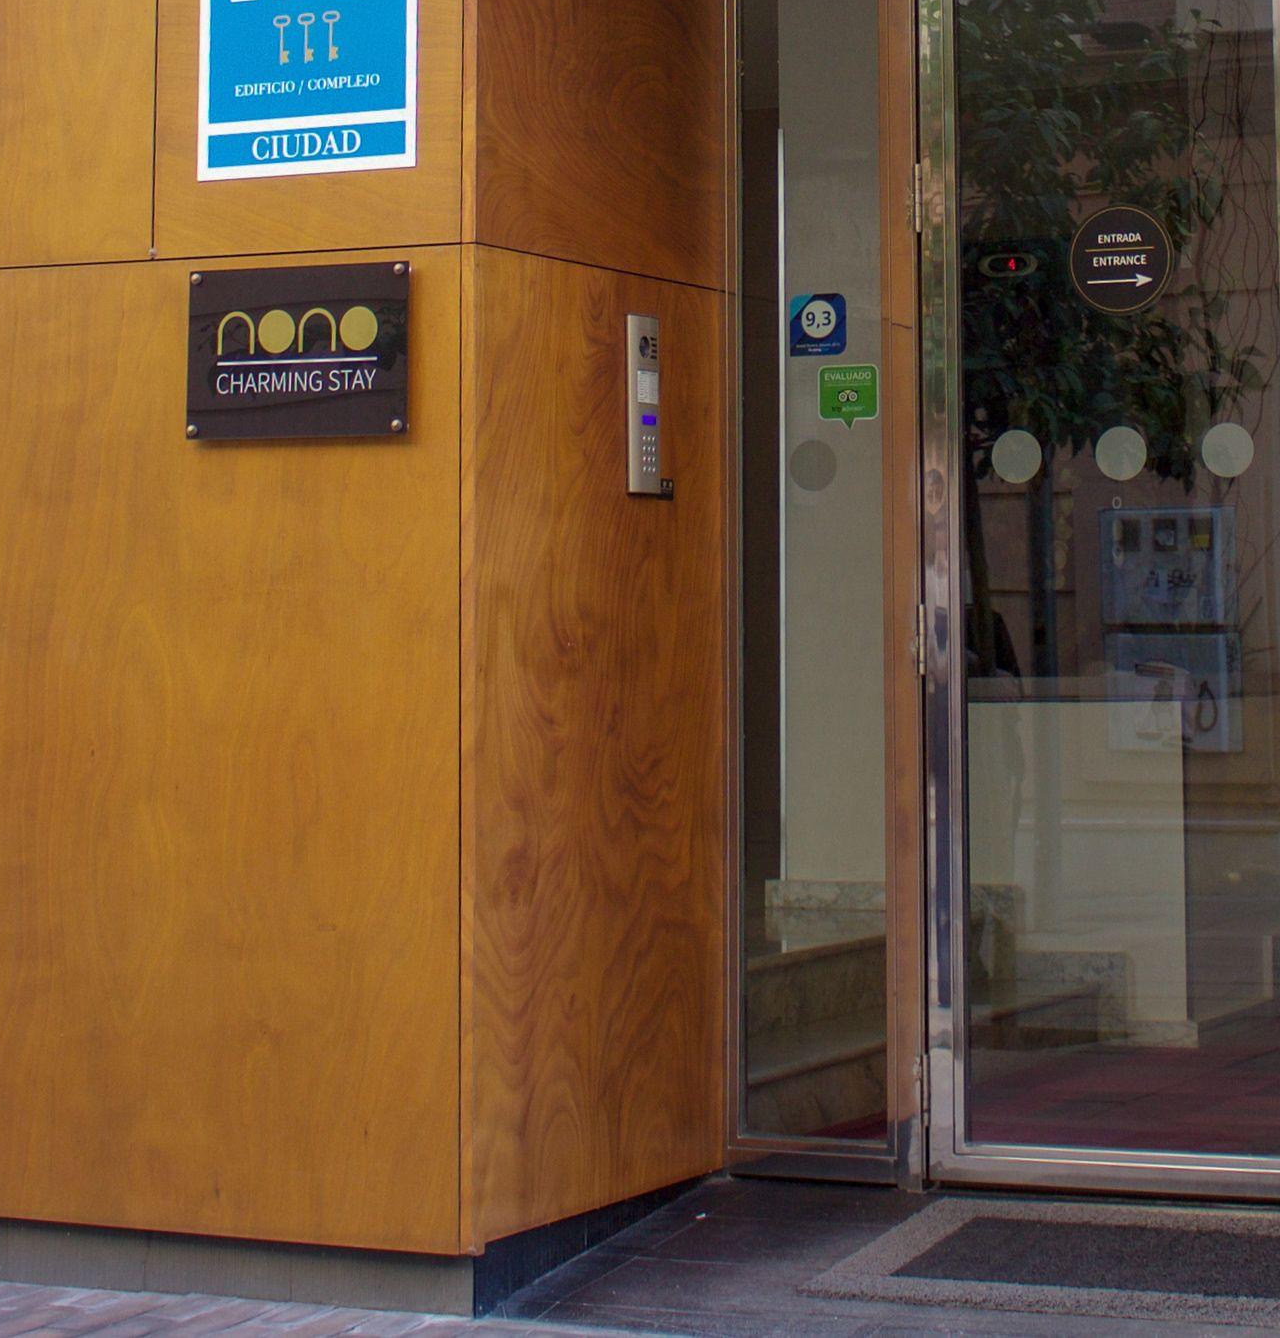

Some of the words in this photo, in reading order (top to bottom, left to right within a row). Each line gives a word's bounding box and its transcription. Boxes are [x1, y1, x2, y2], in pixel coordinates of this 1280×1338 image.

[234, 80, 296, 97] EDIFICIO
[307, 73, 380, 92] COMPLEJO
[252, 129, 361, 160] CIUDAD
[1097, 233, 1142, 244] ENTRADA
[1093, 254, 1147, 267] ENTRANCE
[805, 310, 832, 329] 9,3
[217, 305, 378, 356] nono
[216, 370, 323, 395] CHARMING
[328, 368, 377, 392] STAY
[824, 371, 872, 381] EVALUADO
